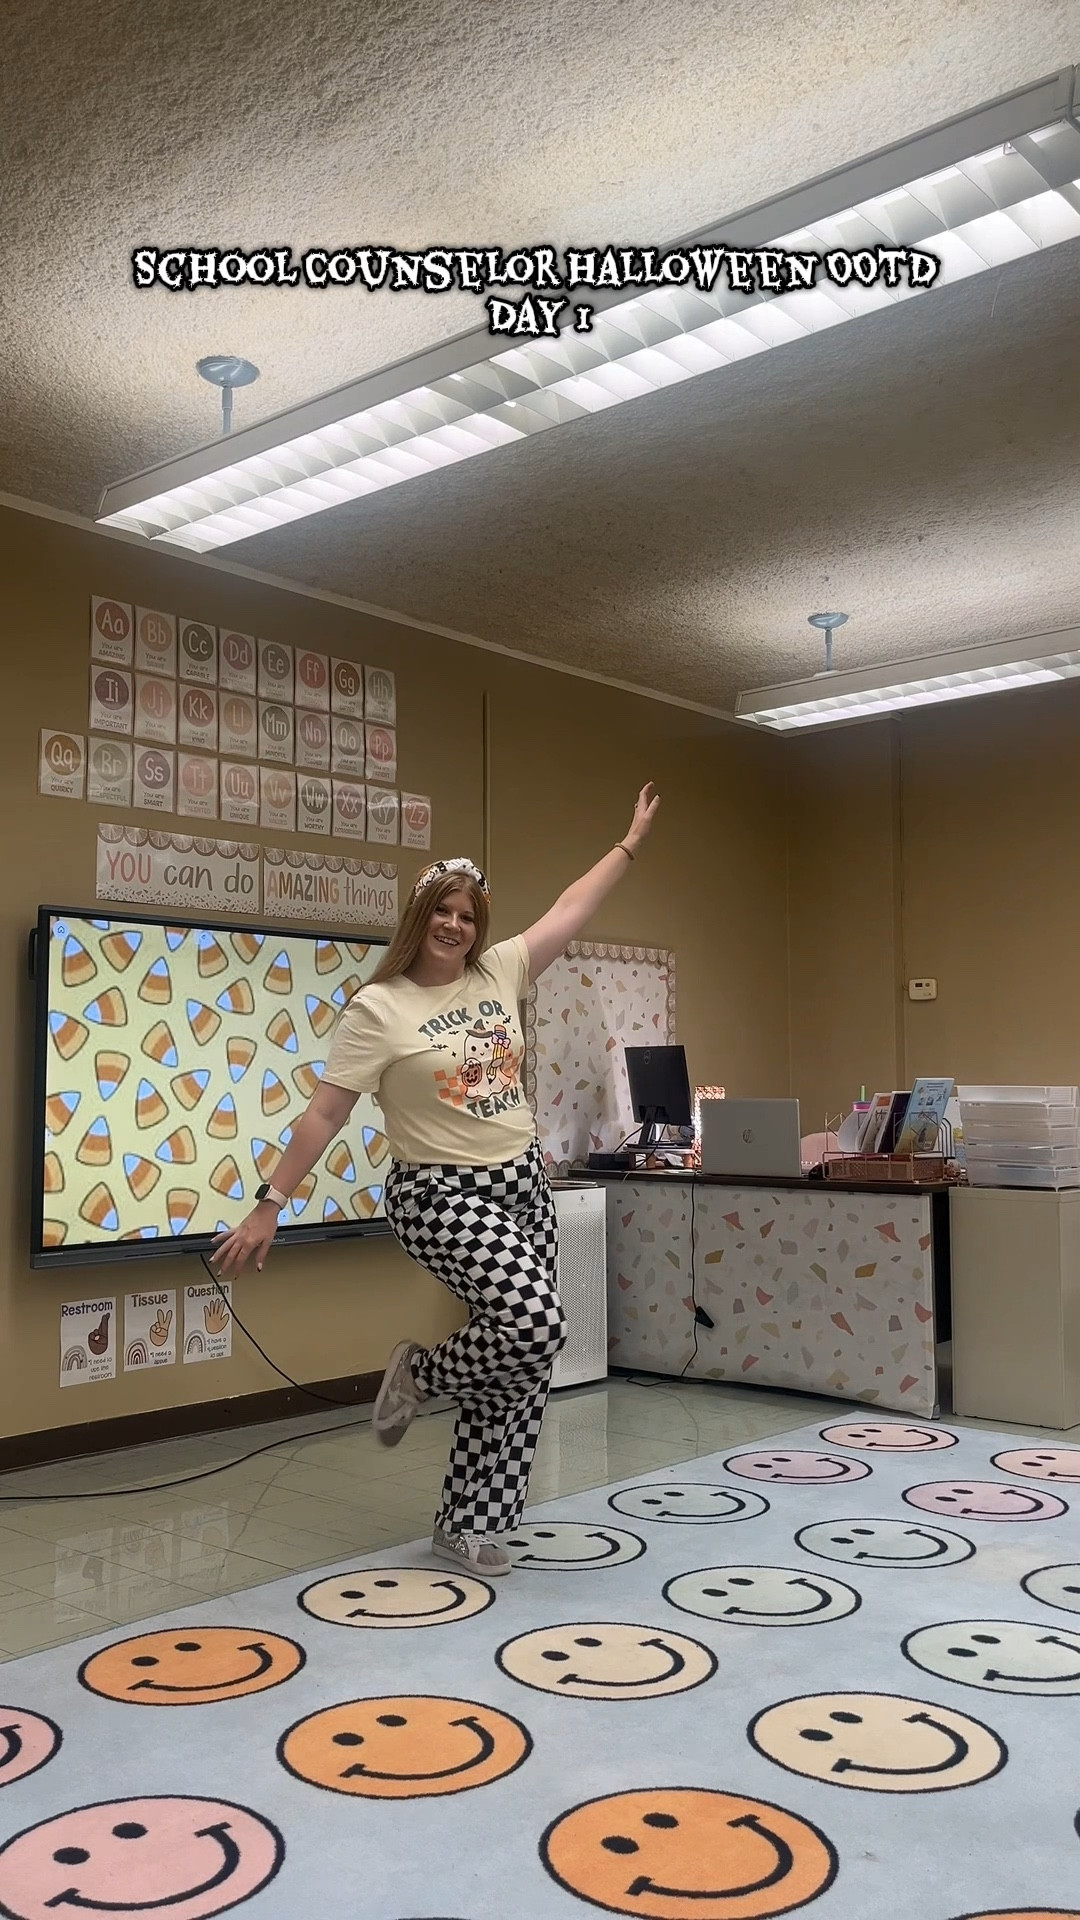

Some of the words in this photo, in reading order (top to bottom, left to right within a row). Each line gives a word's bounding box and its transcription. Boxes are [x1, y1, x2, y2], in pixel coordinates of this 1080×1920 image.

[101, 608, 124, 635] Aa
[147, 620, 166, 644] Bb
[189, 630, 208, 655] Cc
[229, 640, 249, 665] Dd
[268, 650, 285, 673] Ee
[307, 660, 320, 682] Ff
[106, 678, 119, 703] Ii
[339, 668, 355, 695] Gg
[189, 695, 208, 720] Kk
[94, 718, 128, 730] IMPORTANT
[266, 712, 287, 736] Mm
[305, 720, 321, 743] Nn
[340, 728, 356, 750] Oo
[375, 735, 389, 761] Pp
[51, 741, 74, 772] Qq
[101, 750, 122, 776] Rr
[145, 757, 164, 782] Ss
[189, 765, 207, 790] Tt
[50, 784, 74, 793] QUIRKY
[231, 773, 249, 797] Uu
[270, 780, 287, 802] Vv
[305, 784, 324, 808] Ww
[144, 799, 163, 807] SMART
[342, 791, 358, 813] Xx
[106, 850, 152, 885] YOU
[163, 862, 213, 891] can
[224, 862, 254, 894] do
[266, 871, 339, 905] AMAZING
[343, 879, 395, 916] things
[418, 1007, 473, 1038] TRICK
[478, 1000, 506, 1017] OR
[467, 1086, 521, 1119] TEACH
[131, 1292, 168, 1308] Tissue
[187, 1284, 229, 1298] Question
[61, 1300, 113, 1317] Restroom
[89, 1372, 112, 1380] restroom
